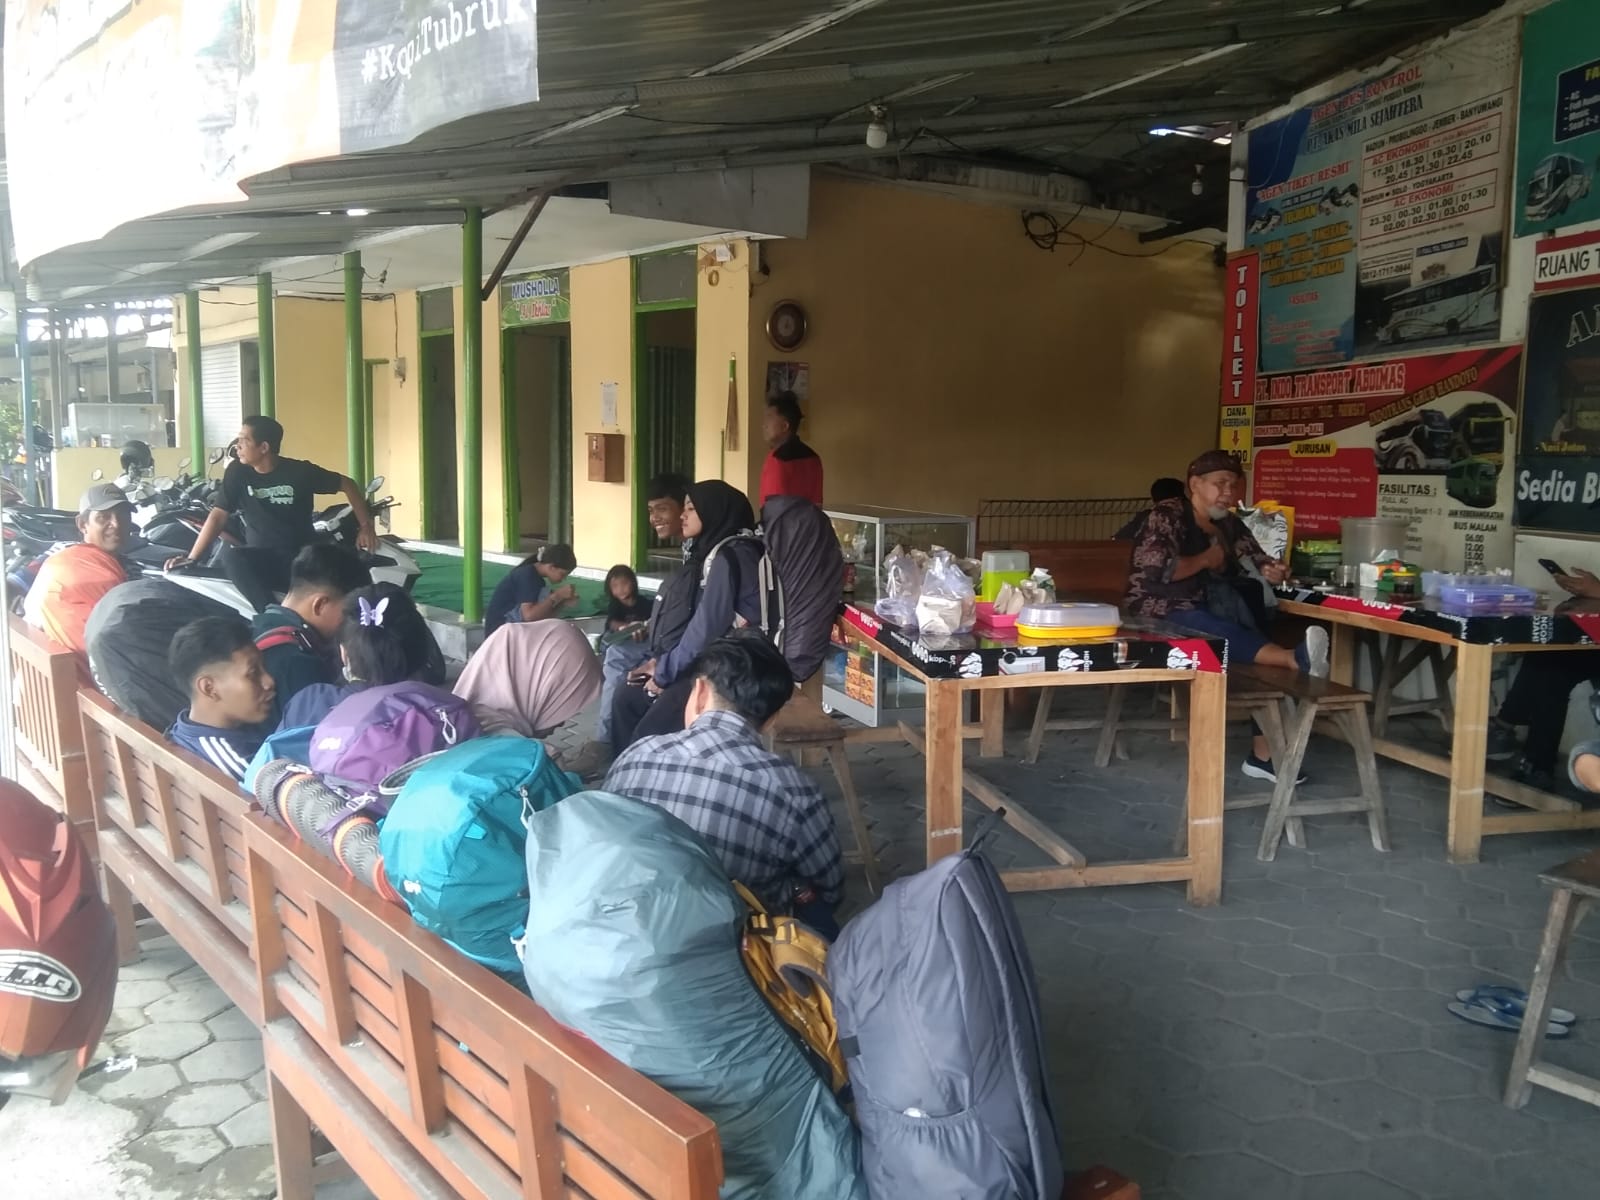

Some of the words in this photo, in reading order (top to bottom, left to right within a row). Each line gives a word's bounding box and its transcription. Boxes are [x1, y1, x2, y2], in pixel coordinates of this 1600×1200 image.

[1370, 94, 1424, 127] SEJAHTERA
[1372, 155, 1385, 166] AC
[1387, 140, 1430, 161] EKONOMI
[1464, 133, 1492, 149] 20.10
[1415, 161, 1440, 175] 21.30
[1447, 150, 1473, 165] 22.45
[1394, 197, 1406, 207] AC
[1408, 183, 1454, 203] EKONOMI
[1398, 206, 1422, 219] 00.30
[1461, 188, 1488, 202] 01.30
[1383, 220, 1406, 232] 02.00
[1412, 212, 1436, 225] 02.30
[1444, 203, 1470, 216] 03.00
[1539, 250, 1590, 279] RUANG
[512, 277, 560, 301] MUSHOLLA
[1232, 266, 1248, 398] TOILET
[1294, 369, 1353, 398] TRANSPORT
[1355, 363, 1406, 393] ABDIMAS
[1227, 408, 1247, 417] DANA
[1295, 443, 1331, 454] JURUSAN
[1379, 484, 1431, 496] FASILITAS
[1517, 469, 1577, 503] Sedia
[1400, 497, 1409, 505] AC
[1453, 521, 1468, 531] BUS
[1469, 522, 1498, 532] MALAM
